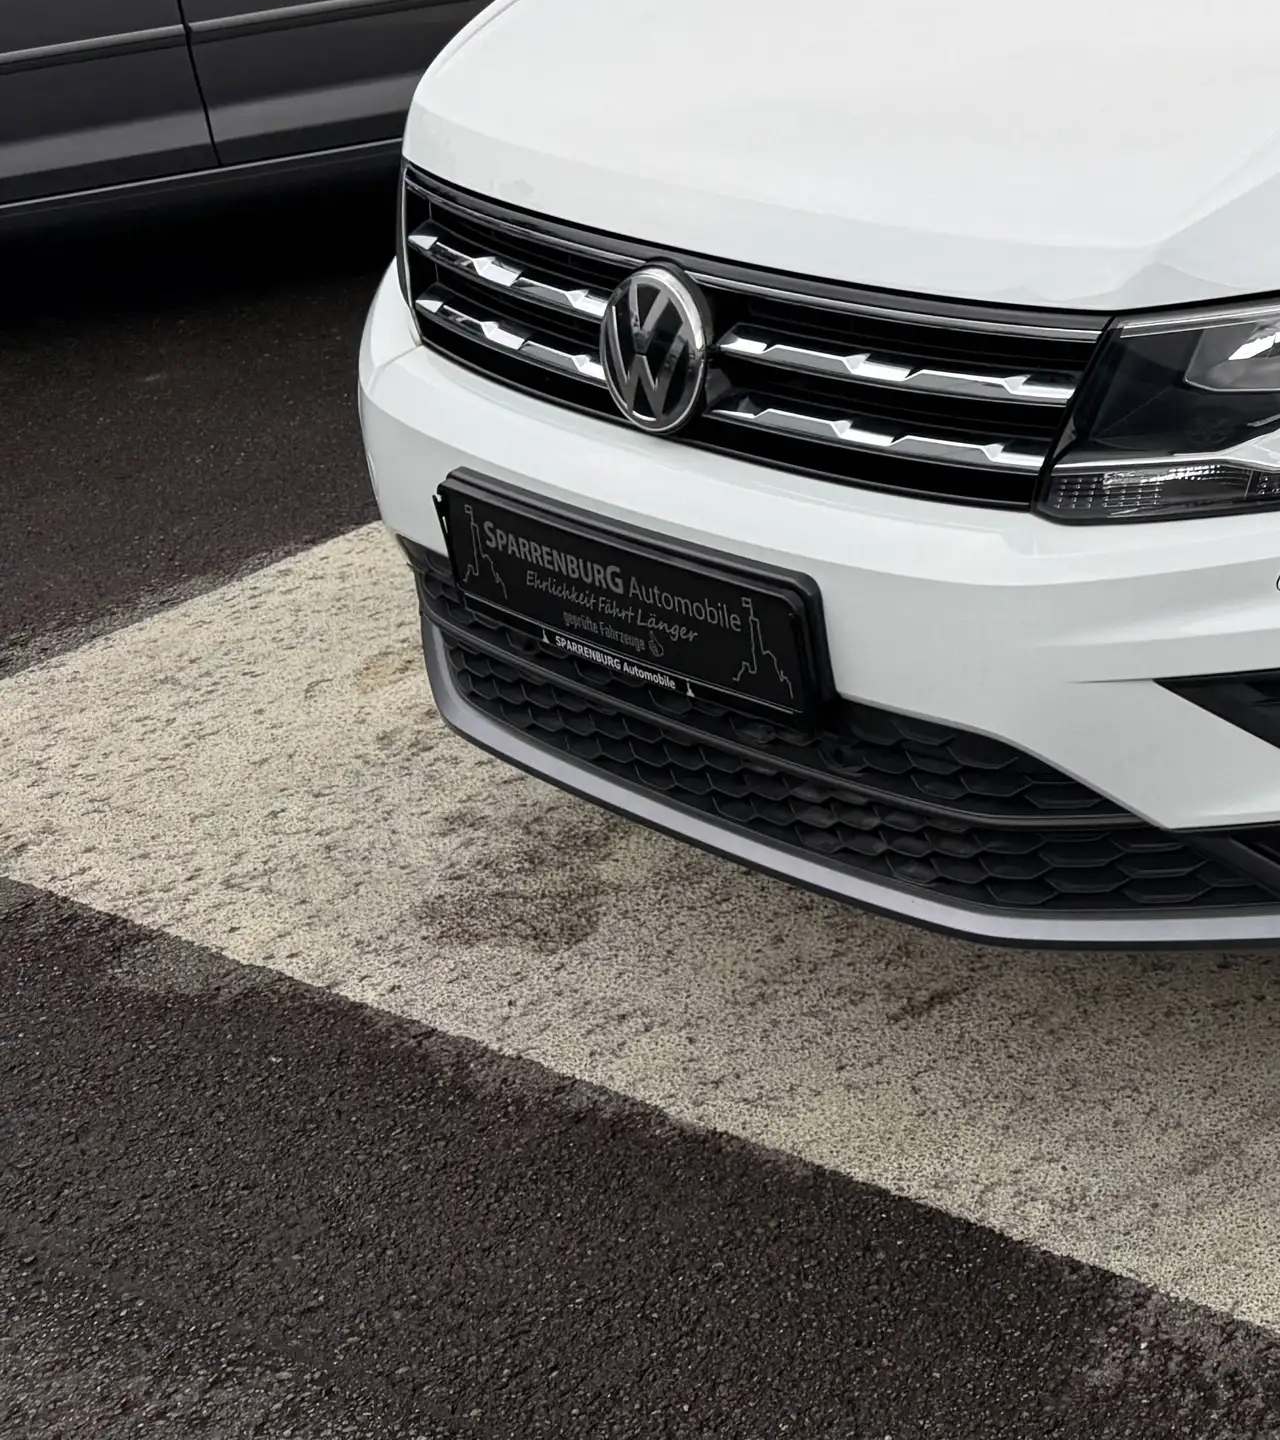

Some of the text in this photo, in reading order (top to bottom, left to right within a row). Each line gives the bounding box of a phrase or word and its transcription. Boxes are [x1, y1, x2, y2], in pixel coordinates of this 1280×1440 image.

[483, 520, 742, 632] SPARRENBURG Automobile
[526, 570, 699, 643] Ehrlichkeit Fährt Länger
[555, 635, 676, 690] SPARRENBURG Automobile
[599, 621, 646, 652] Fahrzeuge
